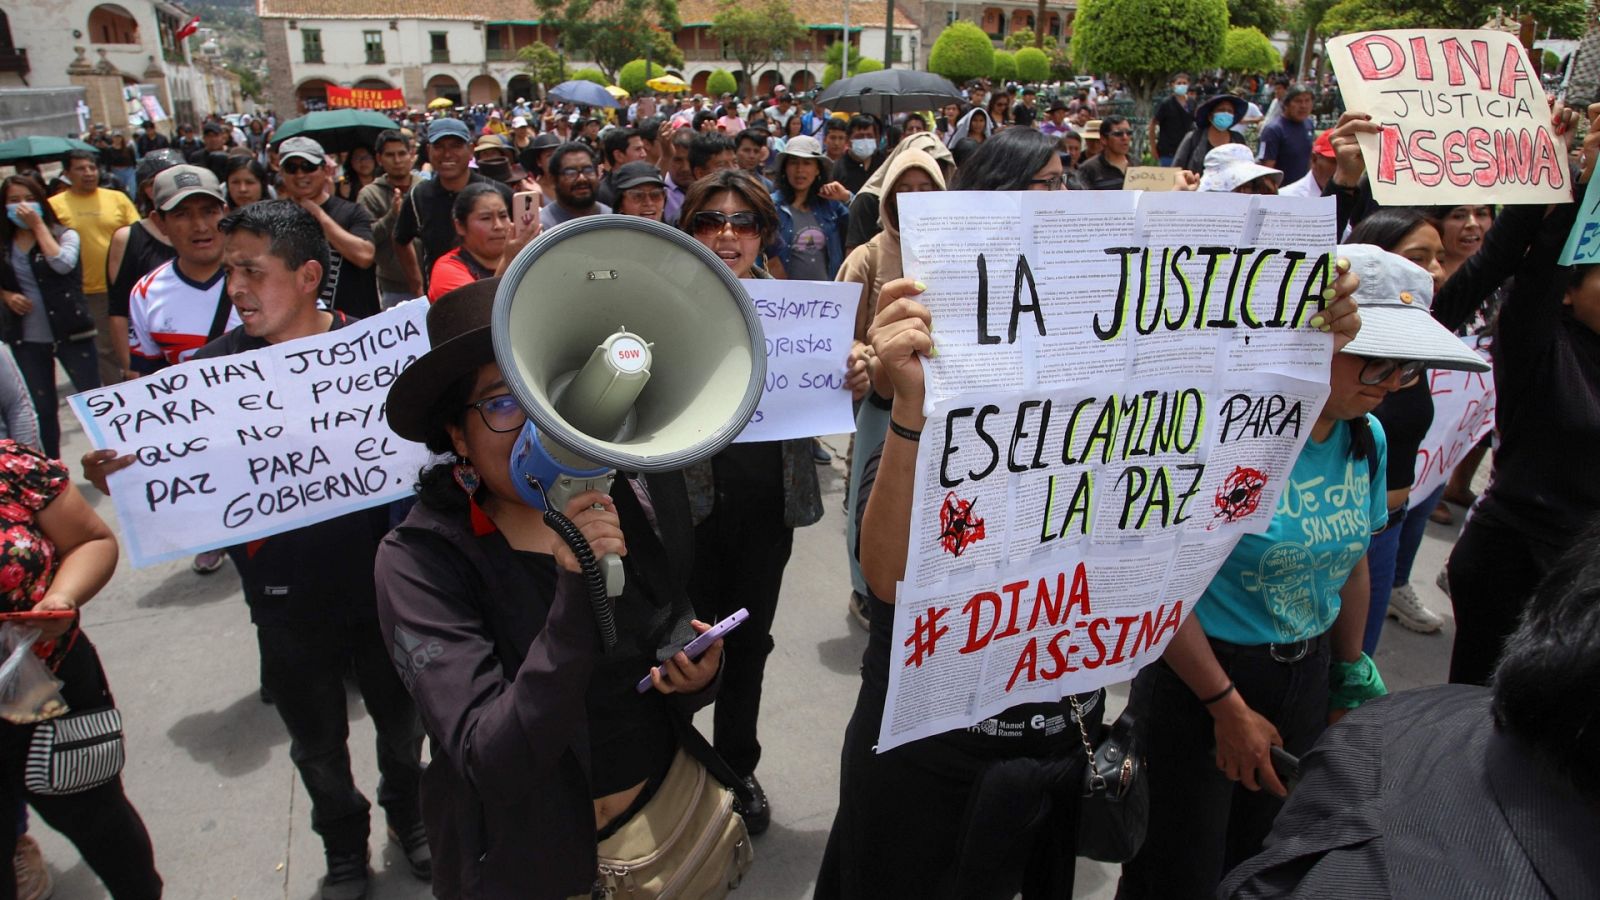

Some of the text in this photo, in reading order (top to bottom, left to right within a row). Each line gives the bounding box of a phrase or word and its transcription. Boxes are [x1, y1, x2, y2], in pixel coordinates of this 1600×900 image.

[351, 89, 383, 100] NUEVA
[1346, 34, 1534, 99] DINA
[1381, 89, 1534, 119] JUSTICIA
[1377, 122, 1563, 190] ASESINA
[976, 253, 1047, 345] LA
[1093, 245, 1333, 342] JUSTICIA
[87, 319, 421, 417] SI NO HAY JUSTICIA
[618, 350, 640, 359] 50W
[799, 372, 842, 390] SON
[110, 398, 215, 442] PARA
[238, 391, 284, 411] EL
[136, 437, 210, 467] QUE
[237, 425, 284, 446] NO
[939, 388, 1300, 488] ES EL CAMINO PARA
[146, 437, 398, 512] PAZ PARA EL
[223, 465, 402, 529] GOBIERNO.
[1040, 464, 1206, 543] LA PAZ
[1005, 600, 1183, 693] ASESINA
[998, 729, 1023, 737] Ramos
[999, 721, 1025, 729] Manuel
